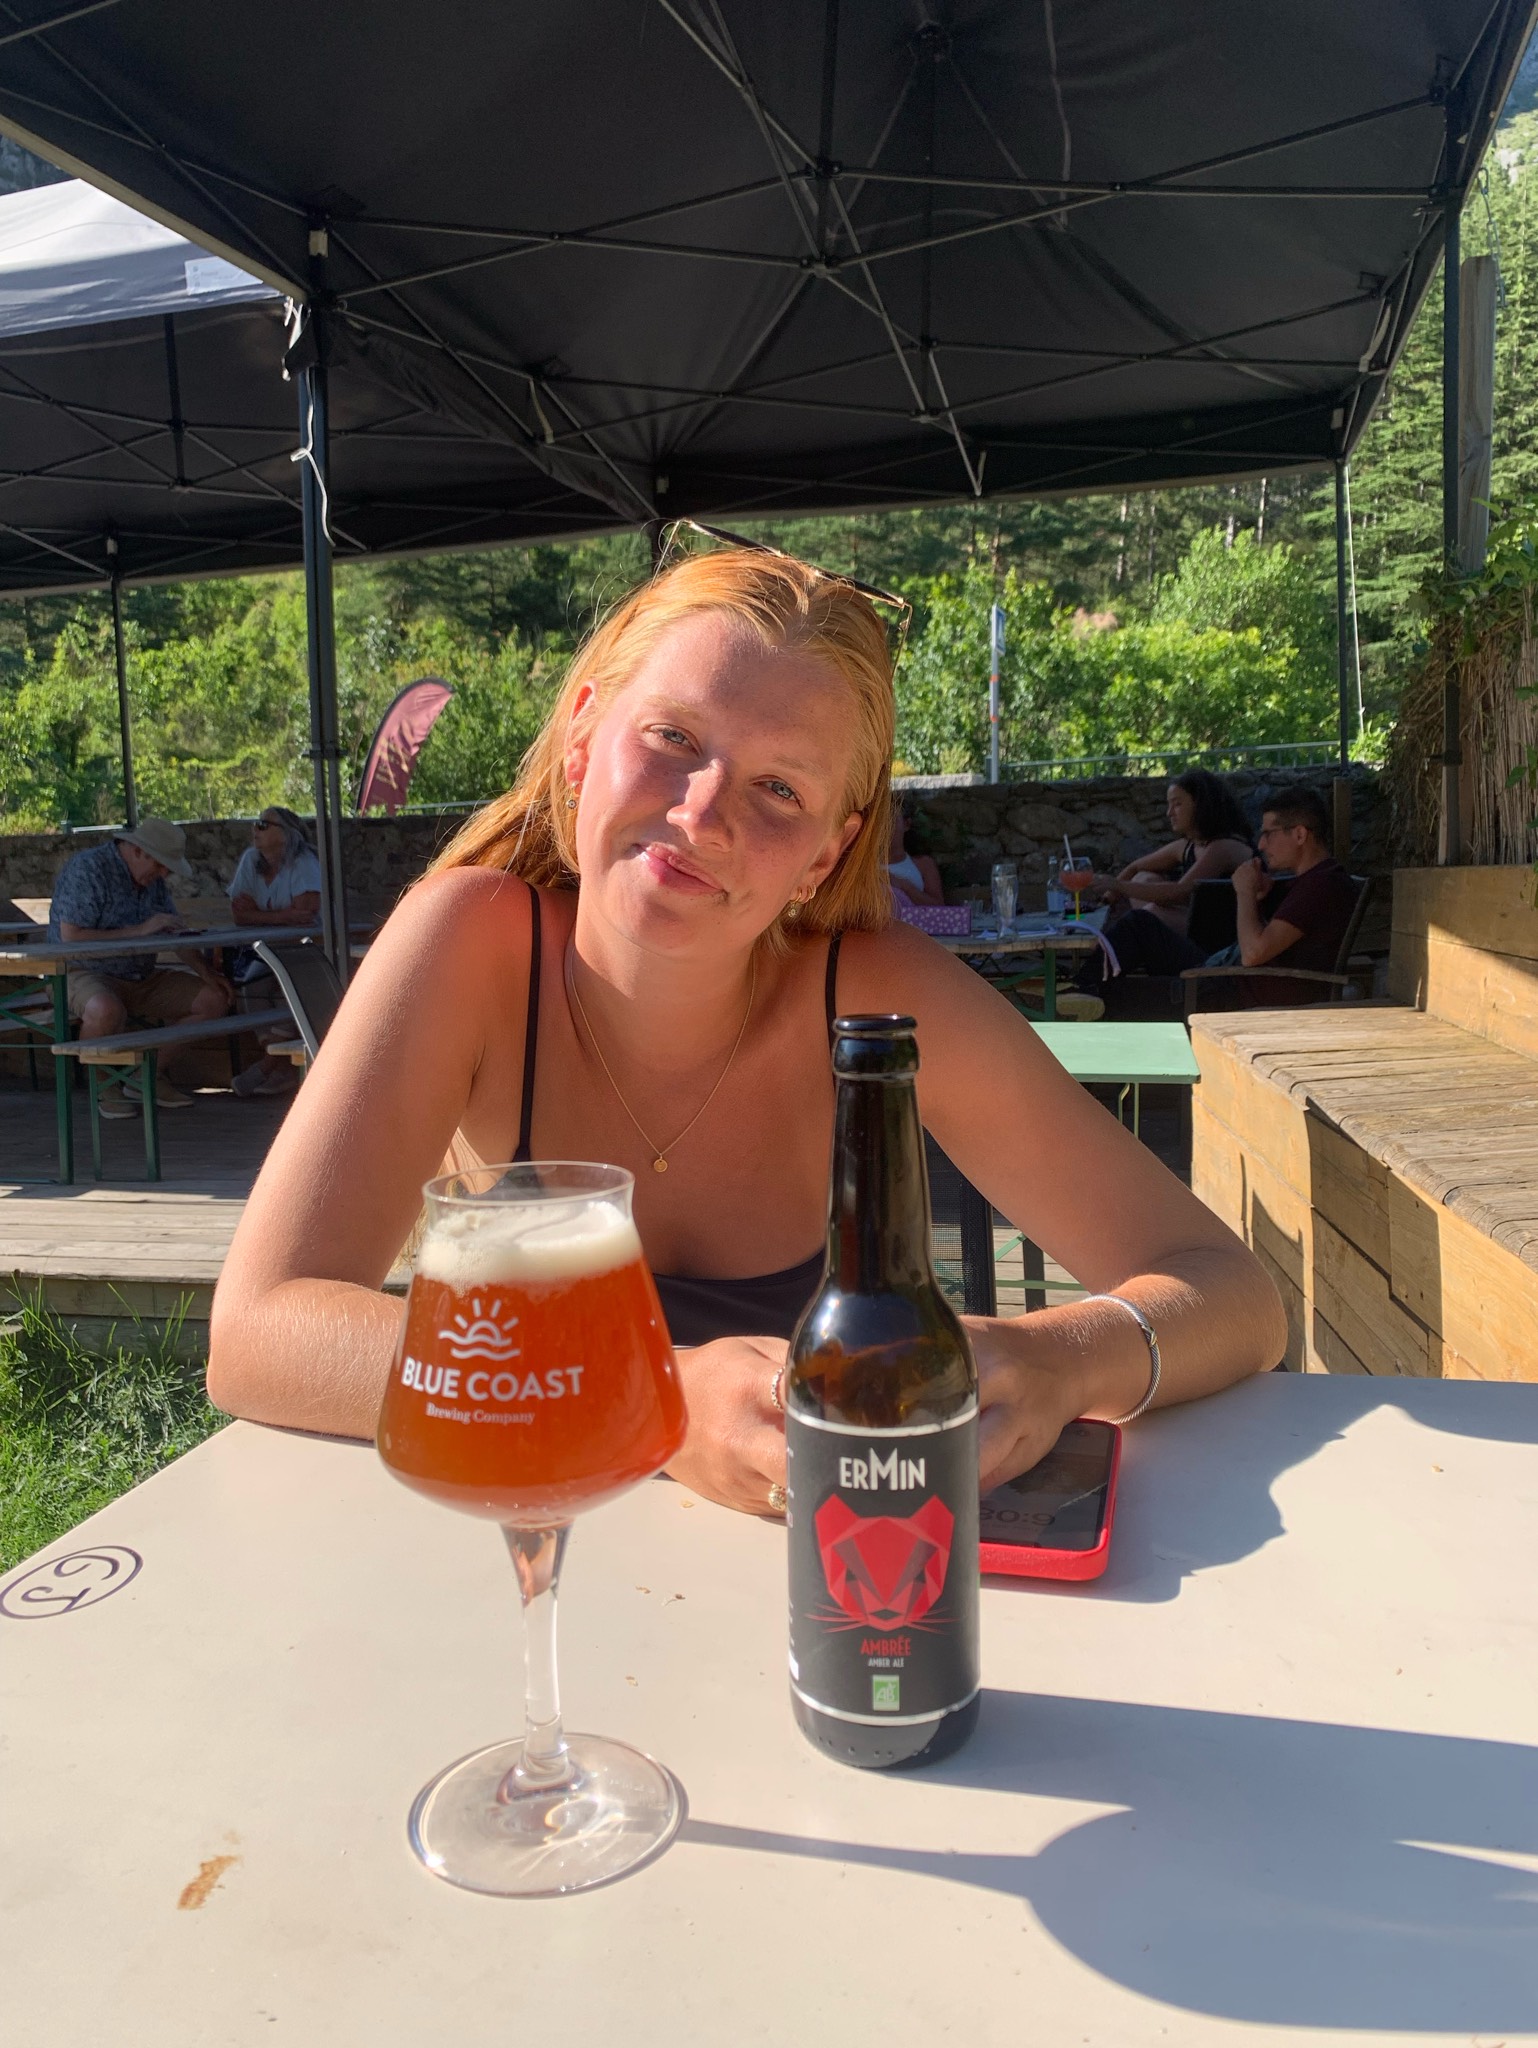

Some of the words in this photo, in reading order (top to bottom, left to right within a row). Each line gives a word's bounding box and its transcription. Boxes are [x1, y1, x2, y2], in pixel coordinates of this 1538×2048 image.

[401, 1356, 461, 1399] BLUE
[466, 1365, 584, 1401] COAST
[426, 1402, 472, 1424] Brewing
[473, 1409, 536, 1425] Company
[860, 1634, 912, 1656] AMBRÉE
[868, 1657, 891, 1668] AMBER
[893, 1657, 905, 1668] ALE
